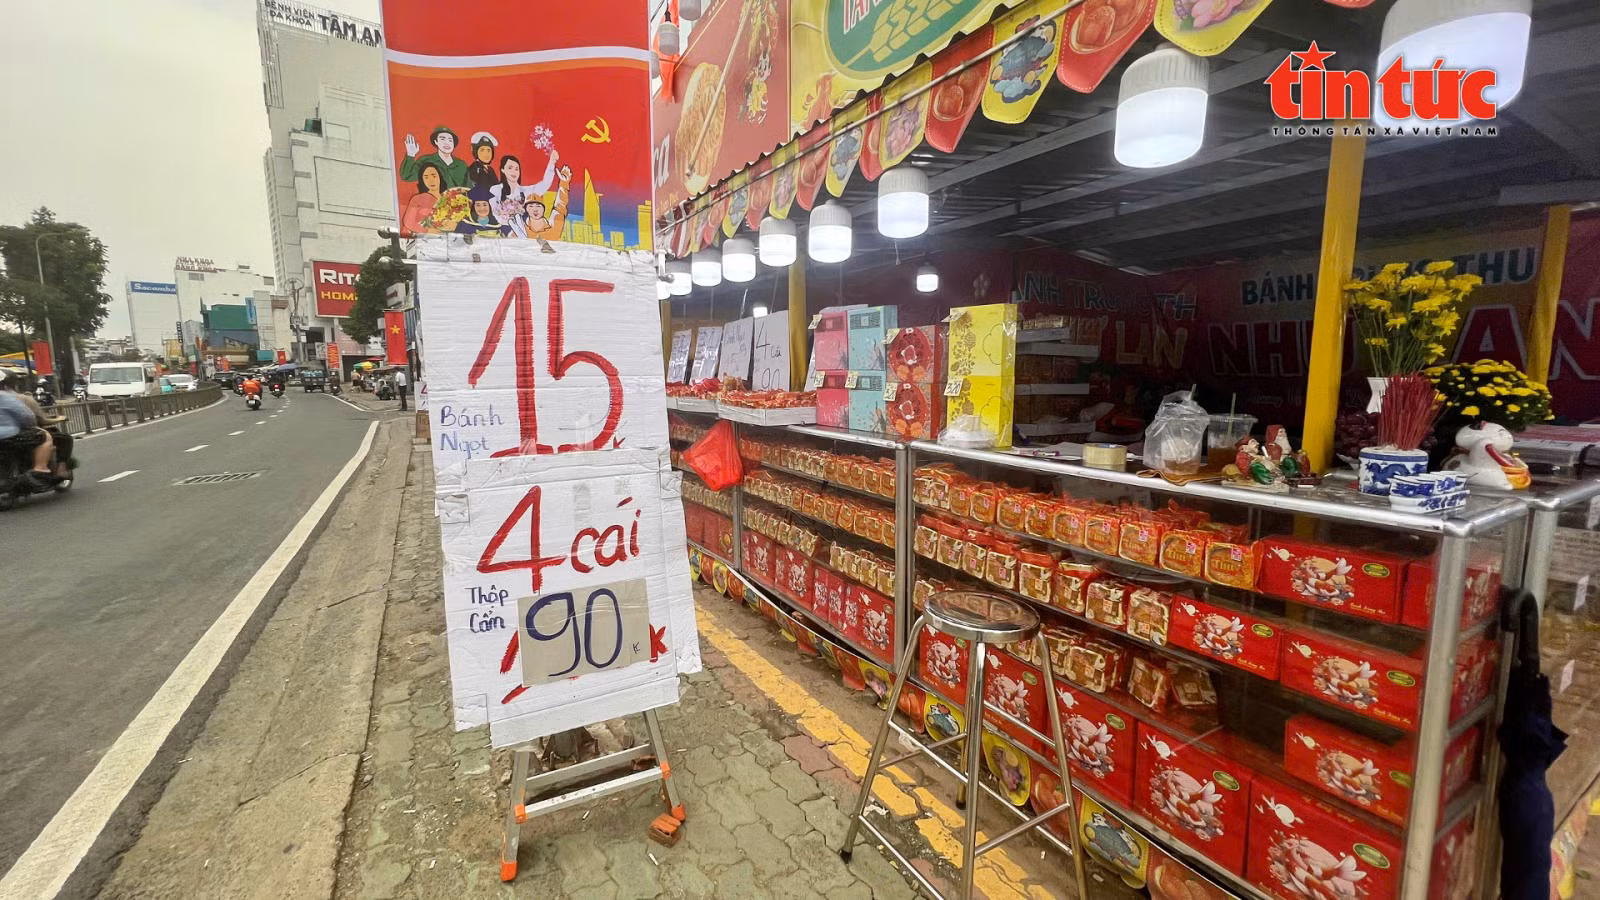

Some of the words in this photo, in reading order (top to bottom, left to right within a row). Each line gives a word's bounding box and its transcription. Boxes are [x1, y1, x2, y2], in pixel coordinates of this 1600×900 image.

[286, 14, 312, 27] KHOA
[294, 7, 315, 20] VIỆN
[317, 14, 357, 39] TÂM
[1241, 271, 1315, 306] BÁNH
[755, 322, 770, 359] 4
[467, 276, 624, 458] 15
[440, 404, 505, 428] Bánh
[439, 430, 490, 459] Ngọt
[476, 485, 568, 595] 4
[571, 496, 641, 574] cái
[525, 587, 623, 677] 90
